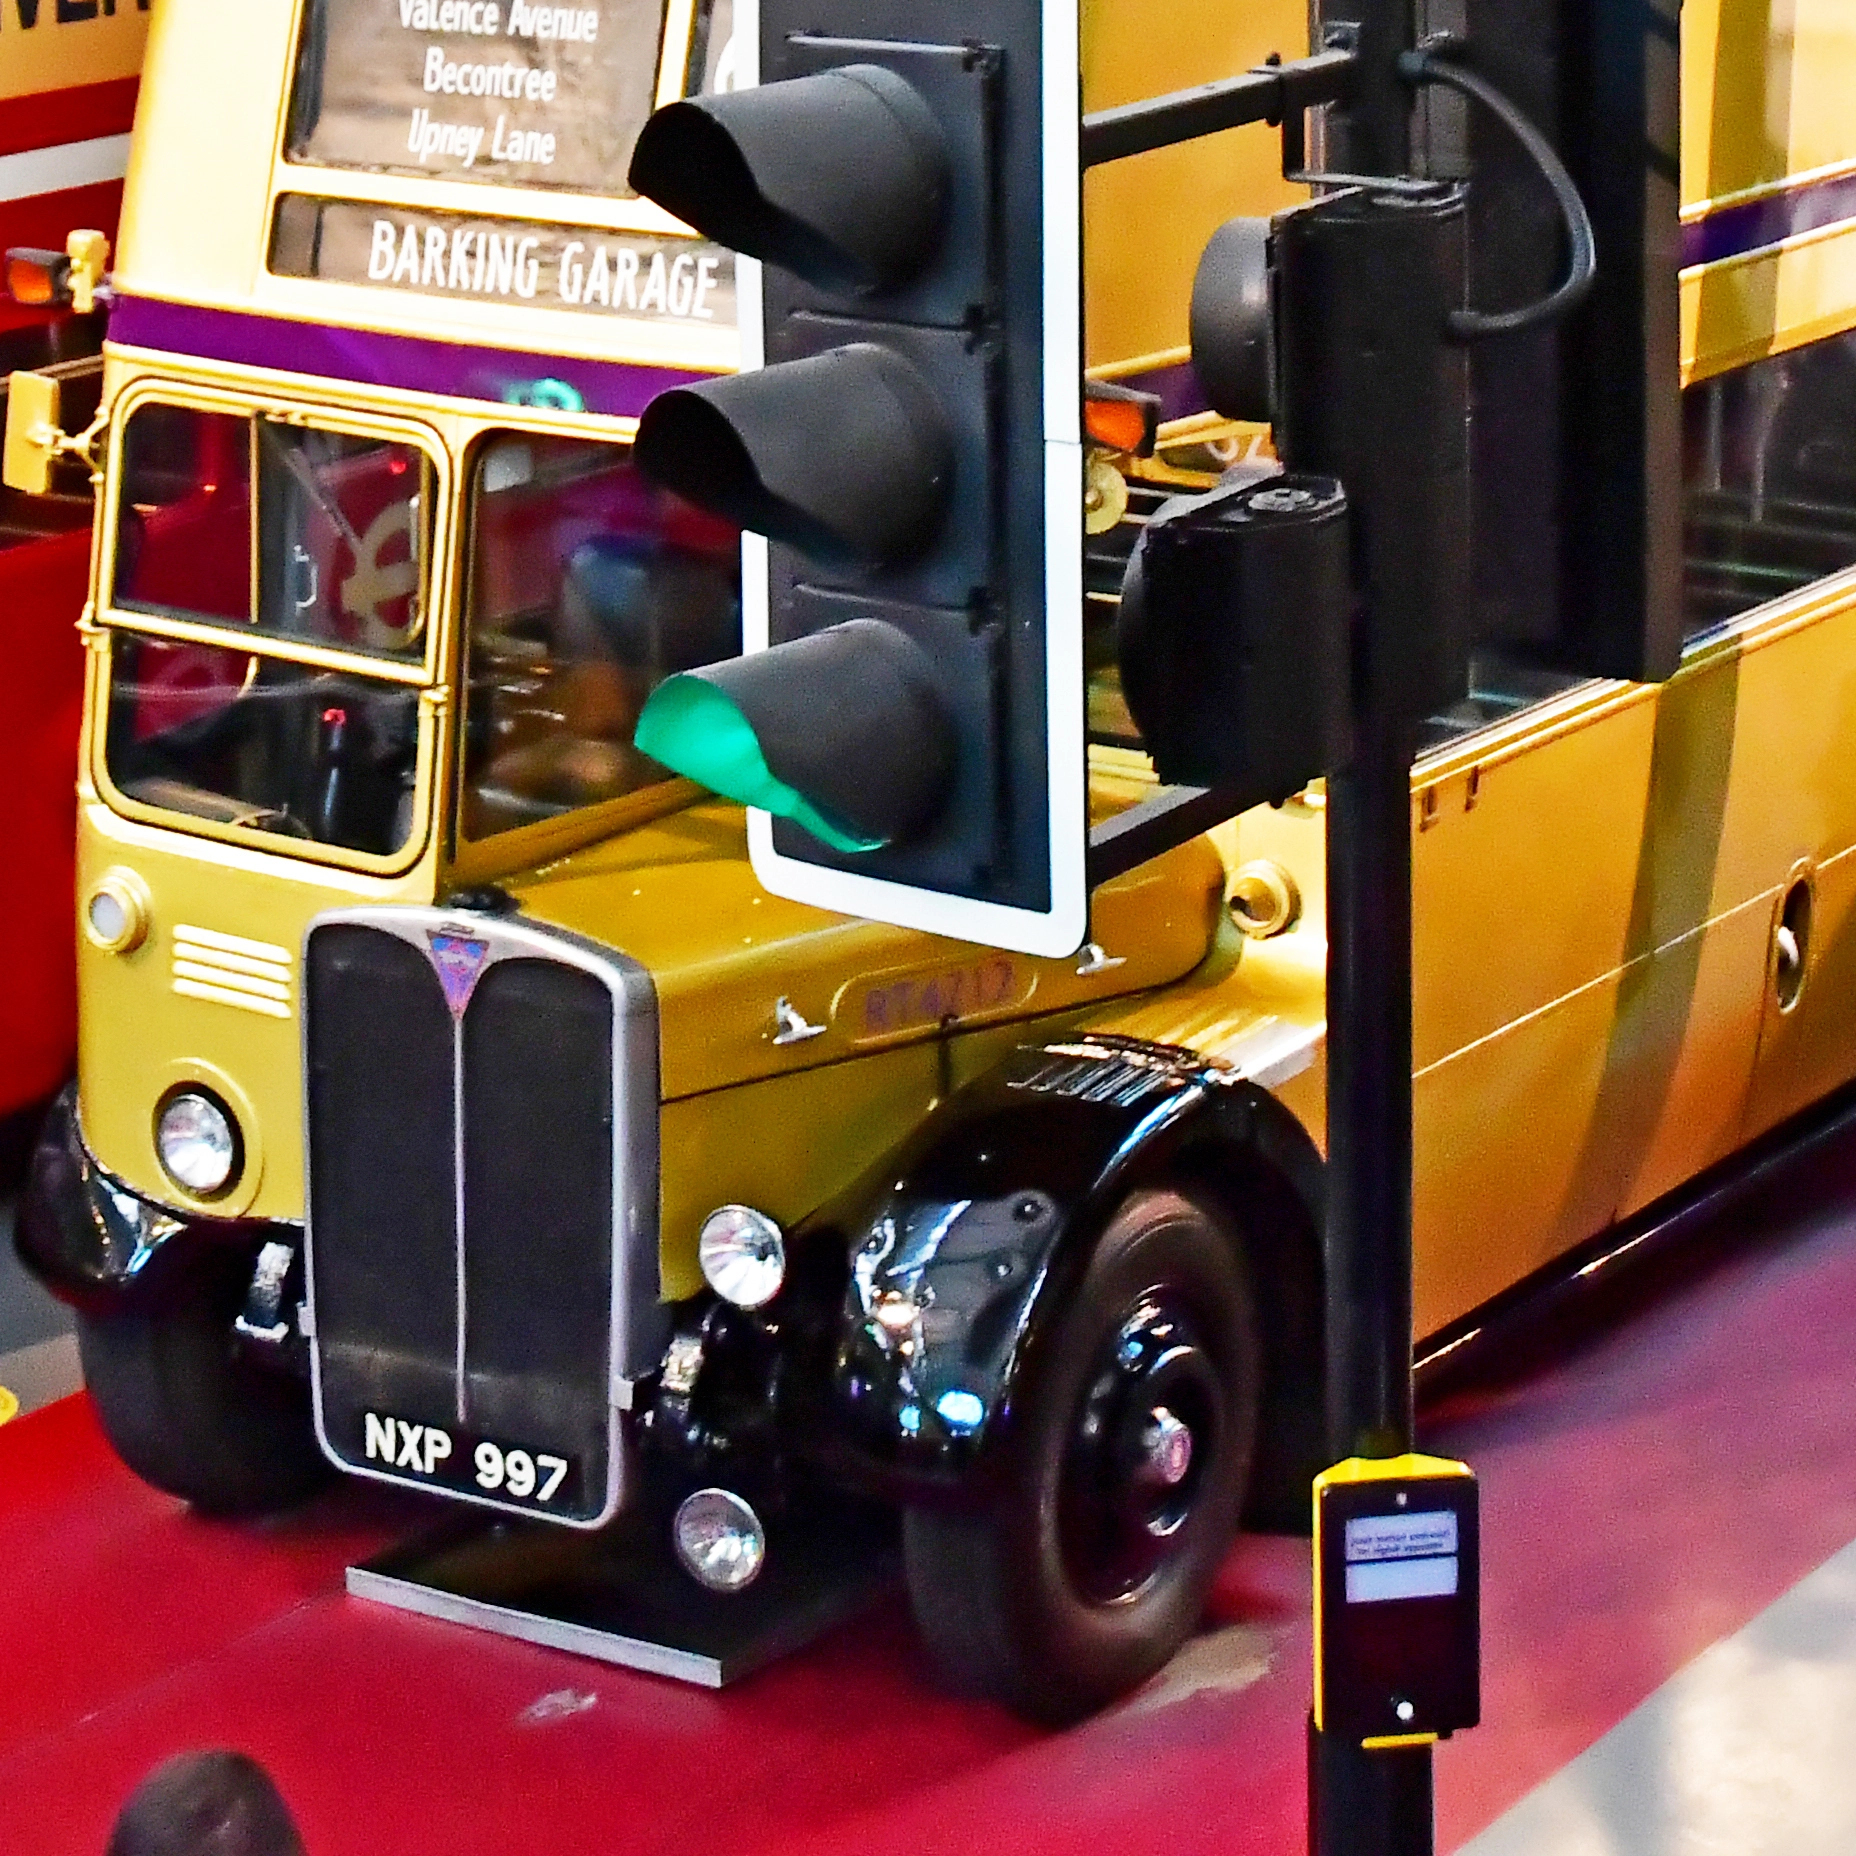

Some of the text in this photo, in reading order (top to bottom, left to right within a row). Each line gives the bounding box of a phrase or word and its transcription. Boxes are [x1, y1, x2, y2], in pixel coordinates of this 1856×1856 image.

[422, 45, 557, 102] Becontree
[407, 107, 556, 168] Upney Lane
[367, 219, 720, 318] BARKING GARAGE
[364, 1412, 568, 1502] NXP 997
